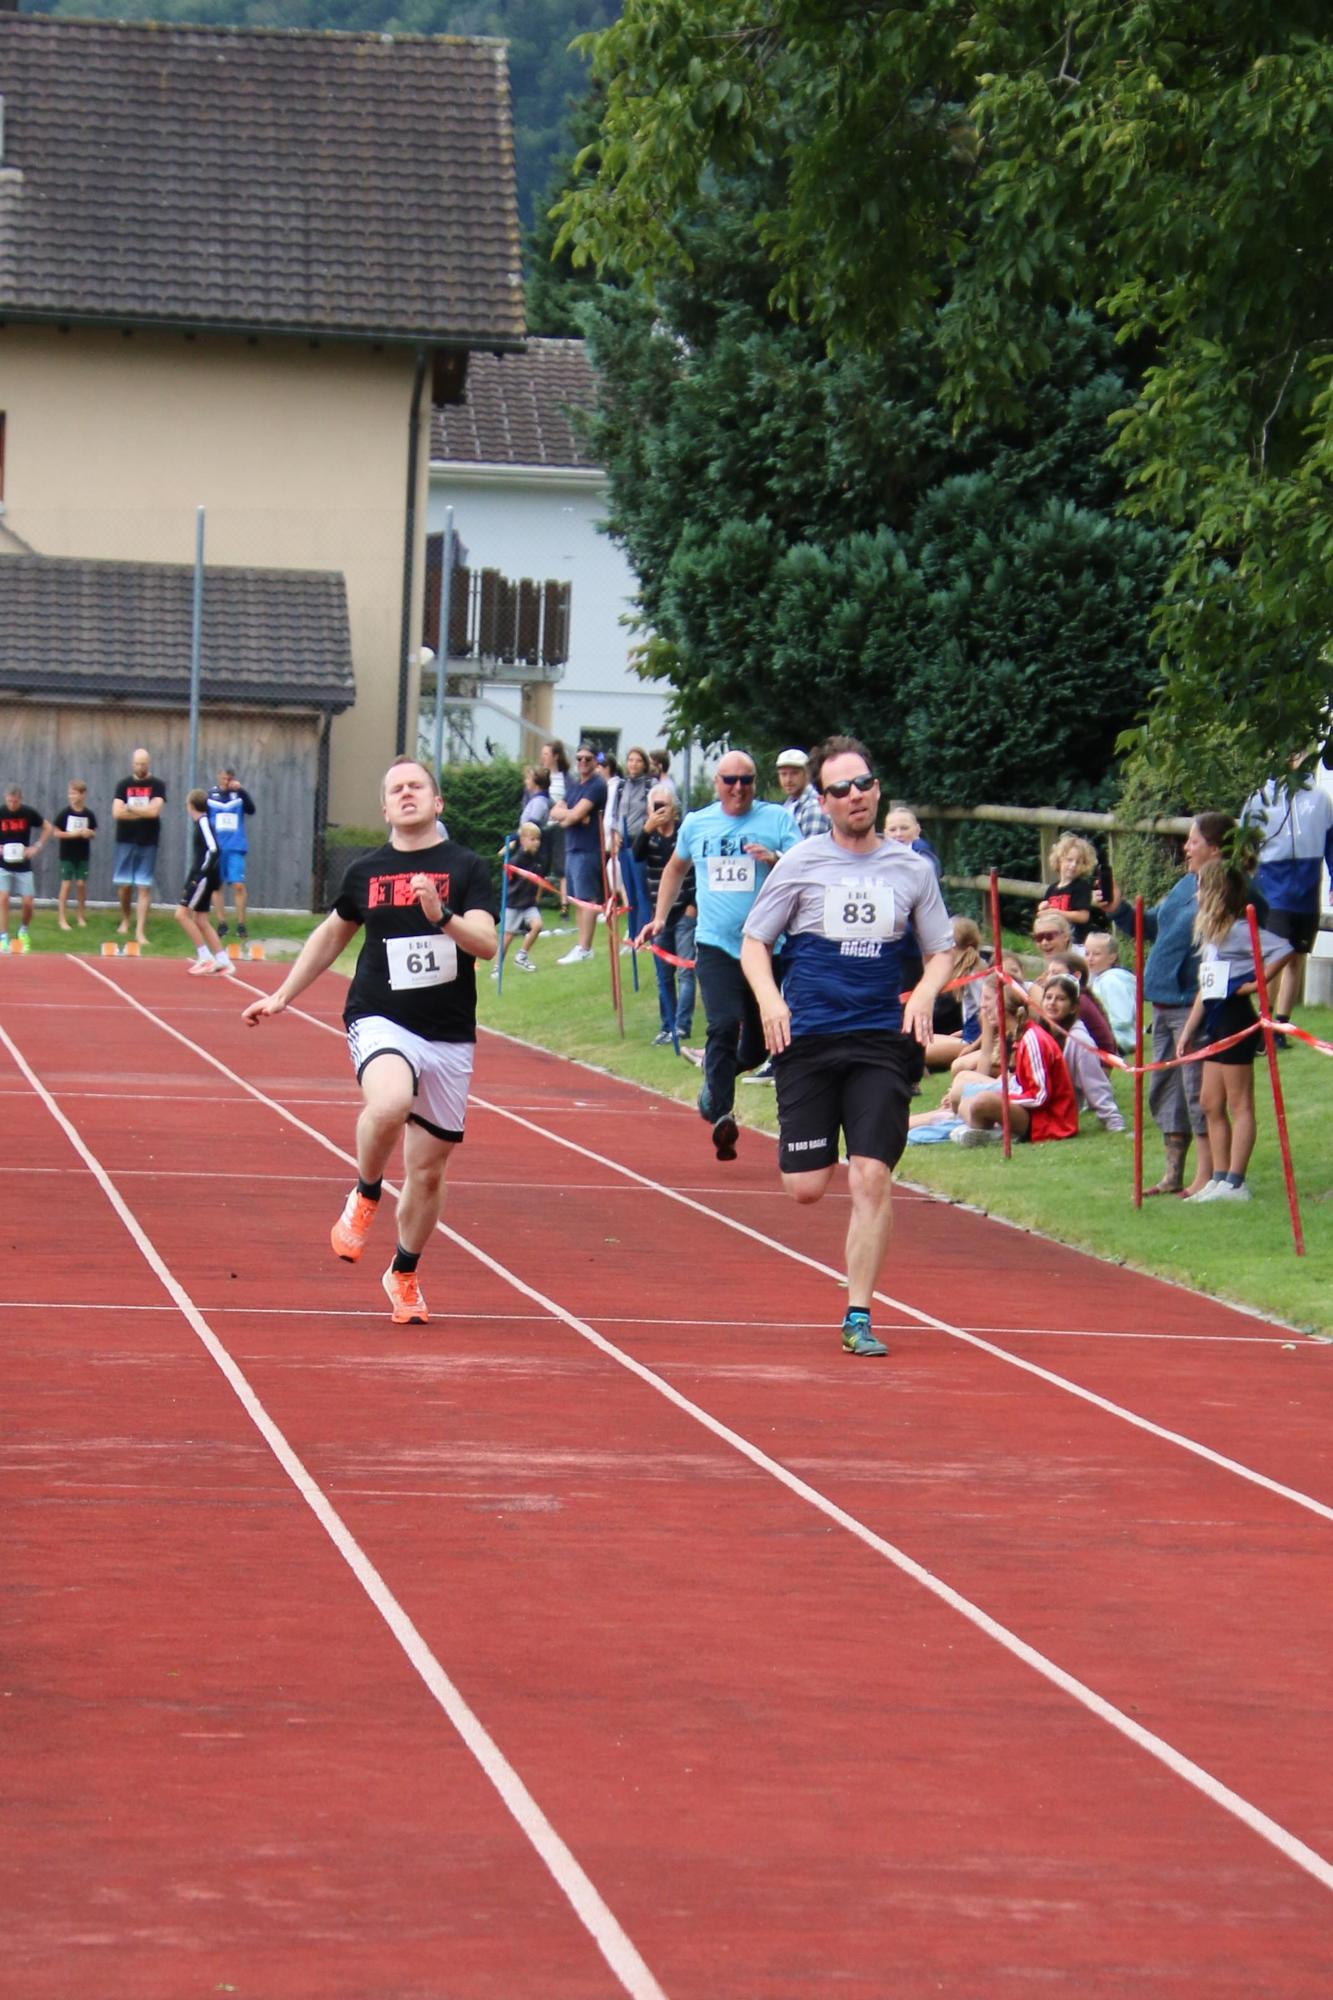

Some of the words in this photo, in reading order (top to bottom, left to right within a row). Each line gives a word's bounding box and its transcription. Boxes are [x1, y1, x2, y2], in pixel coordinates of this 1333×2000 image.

[715, 867, 748, 882] 116
[843, 903, 877, 924] 83
[407, 951, 440, 974] 61
